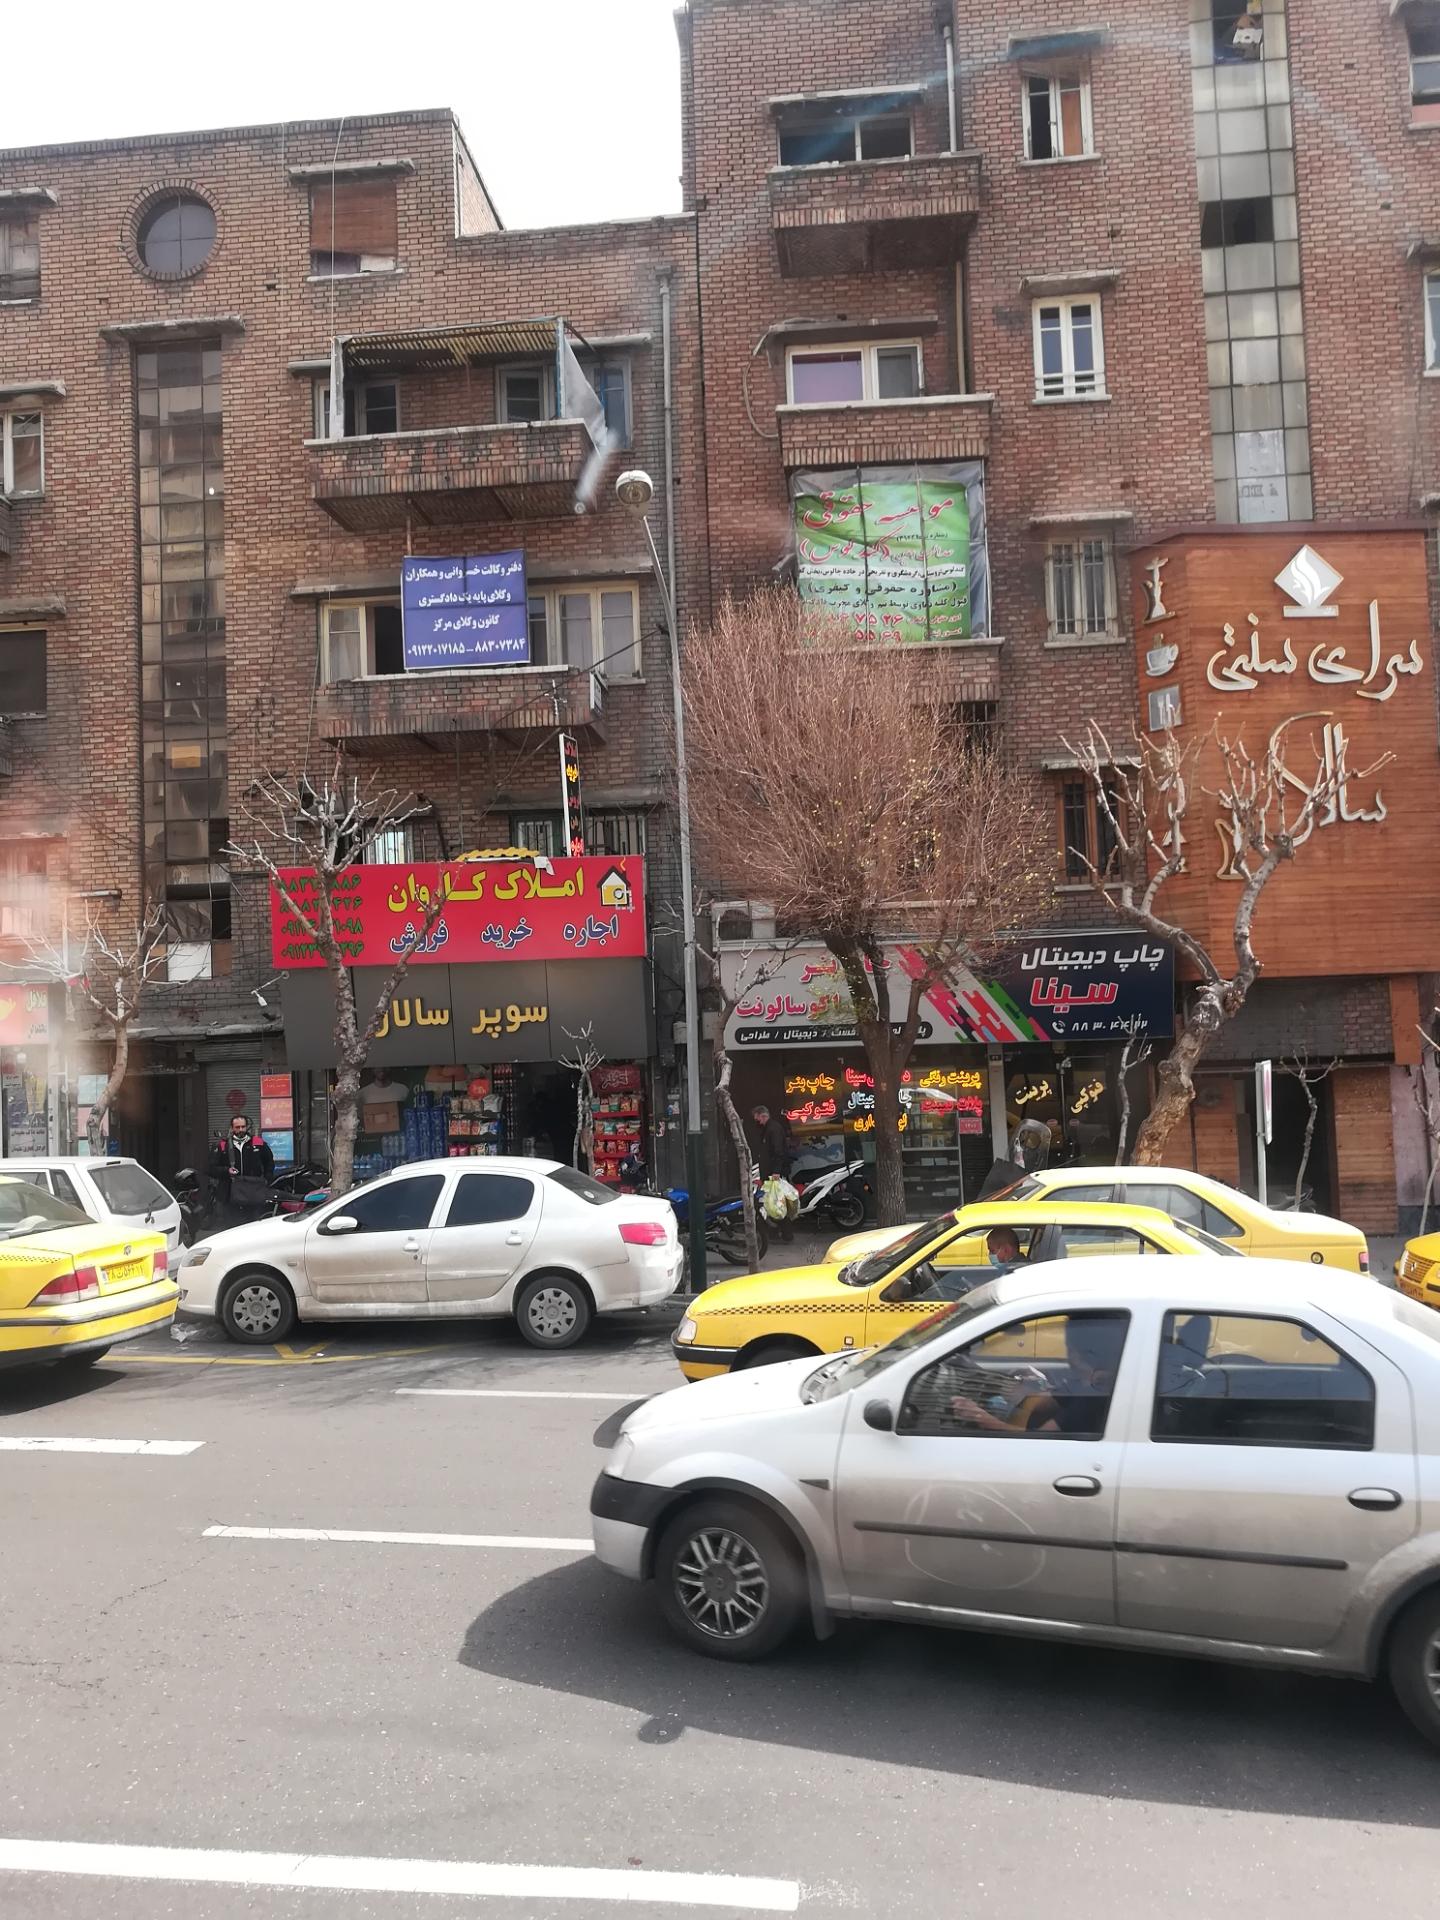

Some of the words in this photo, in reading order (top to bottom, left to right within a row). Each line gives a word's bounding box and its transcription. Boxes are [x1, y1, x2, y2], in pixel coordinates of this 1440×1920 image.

[405, 567, 439, 582] همکاران
[444, 565, 481, 580] خسوانی
[481, 562, 505, 576] وکالت
[505, 561, 522, 576] دفتر
[418, 592, 458, 607] دادگستری
[472, 591, 487, 603] پایه
[487, 589, 511, 602] وکلای
[432, 618, 453, 632] مرکز
[453, 616, 477, 630] وکلای
[477, 614, 500, 629] کانون
[475, 637, 526, 653] ۸۸۳۰۷۳۸۴
[1206, 612, 1298, 691] سنتی
[1308, 599, 1425, 701] سرای
[494, 866, 585, 900] املاک
[389, 919, 450, 954] فروش
[481, 916, 534, 950] خرید
[562, 914, 619, 948] اجاره
[1021, 947, 1107, 970] دیجیتال
[1113, 944, 1165, 973] چاپ
[1030, 977, 1119, 1014] سینا
[375, 998, 450, 1037] سالار
[472, 1002, 548, 1039] سوپر
[740, 1030, 771, 1041] طراحی
[783, 1028, 818, 1041] دیجیتال
[785, 1076, 806, 1094] بنر
[806, 1073, 835, 1094] چاپ
[845, 1067, 867, 1087] سینا
[947, 1070, 982, 1089] پرینت
[1015, 1079, 1053, 1105] پرینت
[786, 1098, 837, 1123] فتوکپی
